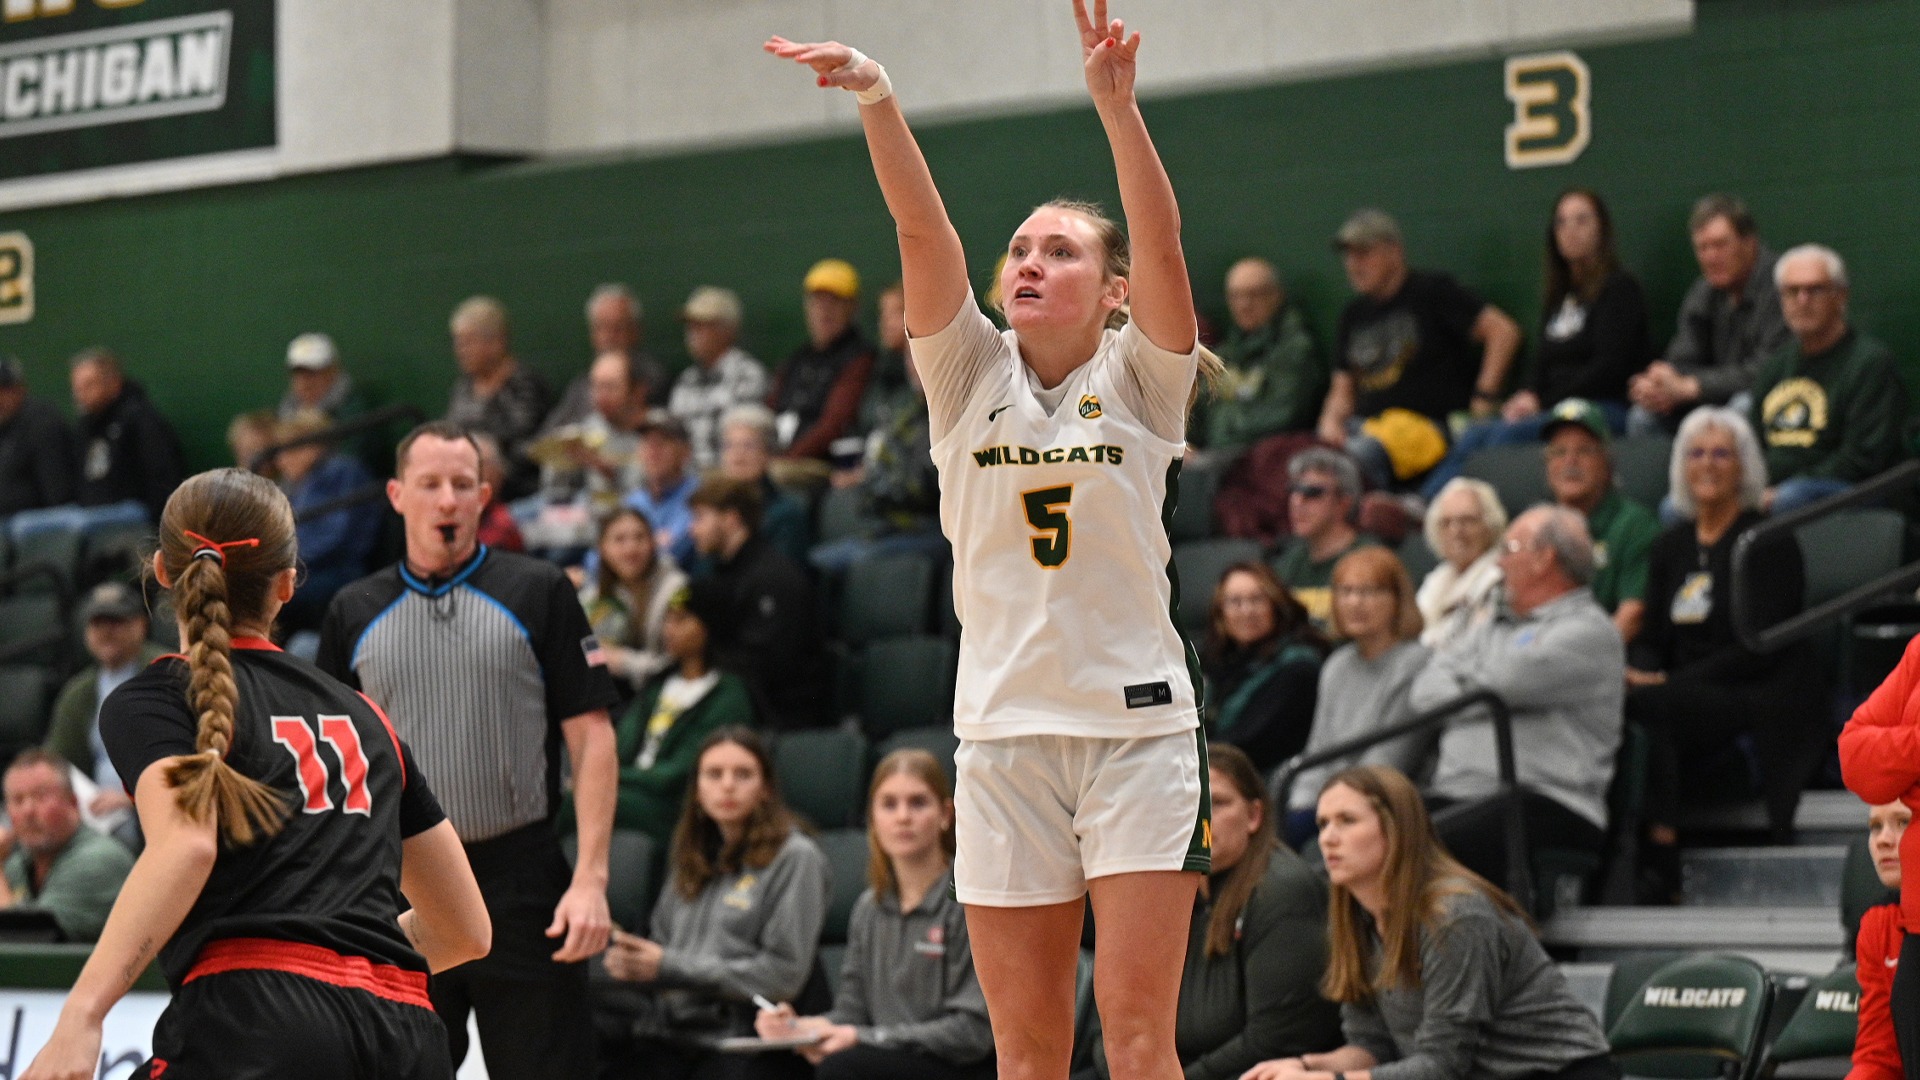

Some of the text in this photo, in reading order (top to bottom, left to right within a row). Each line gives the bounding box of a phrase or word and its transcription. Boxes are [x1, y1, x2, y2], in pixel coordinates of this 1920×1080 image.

[0, 31, 218, 118] CHIGAN
[1505, 51, 1590, 167] 3
[973, 444, 1125, 468] WILDCATS
[1020, 483, 1074, 570] 5
[1158, 687, 1166, 697] M
[270, 714, 372, 818] 11
[1644, 987, 1747, 1008] WILDCATS
[1815, 990, 1858, 1013] WIL
